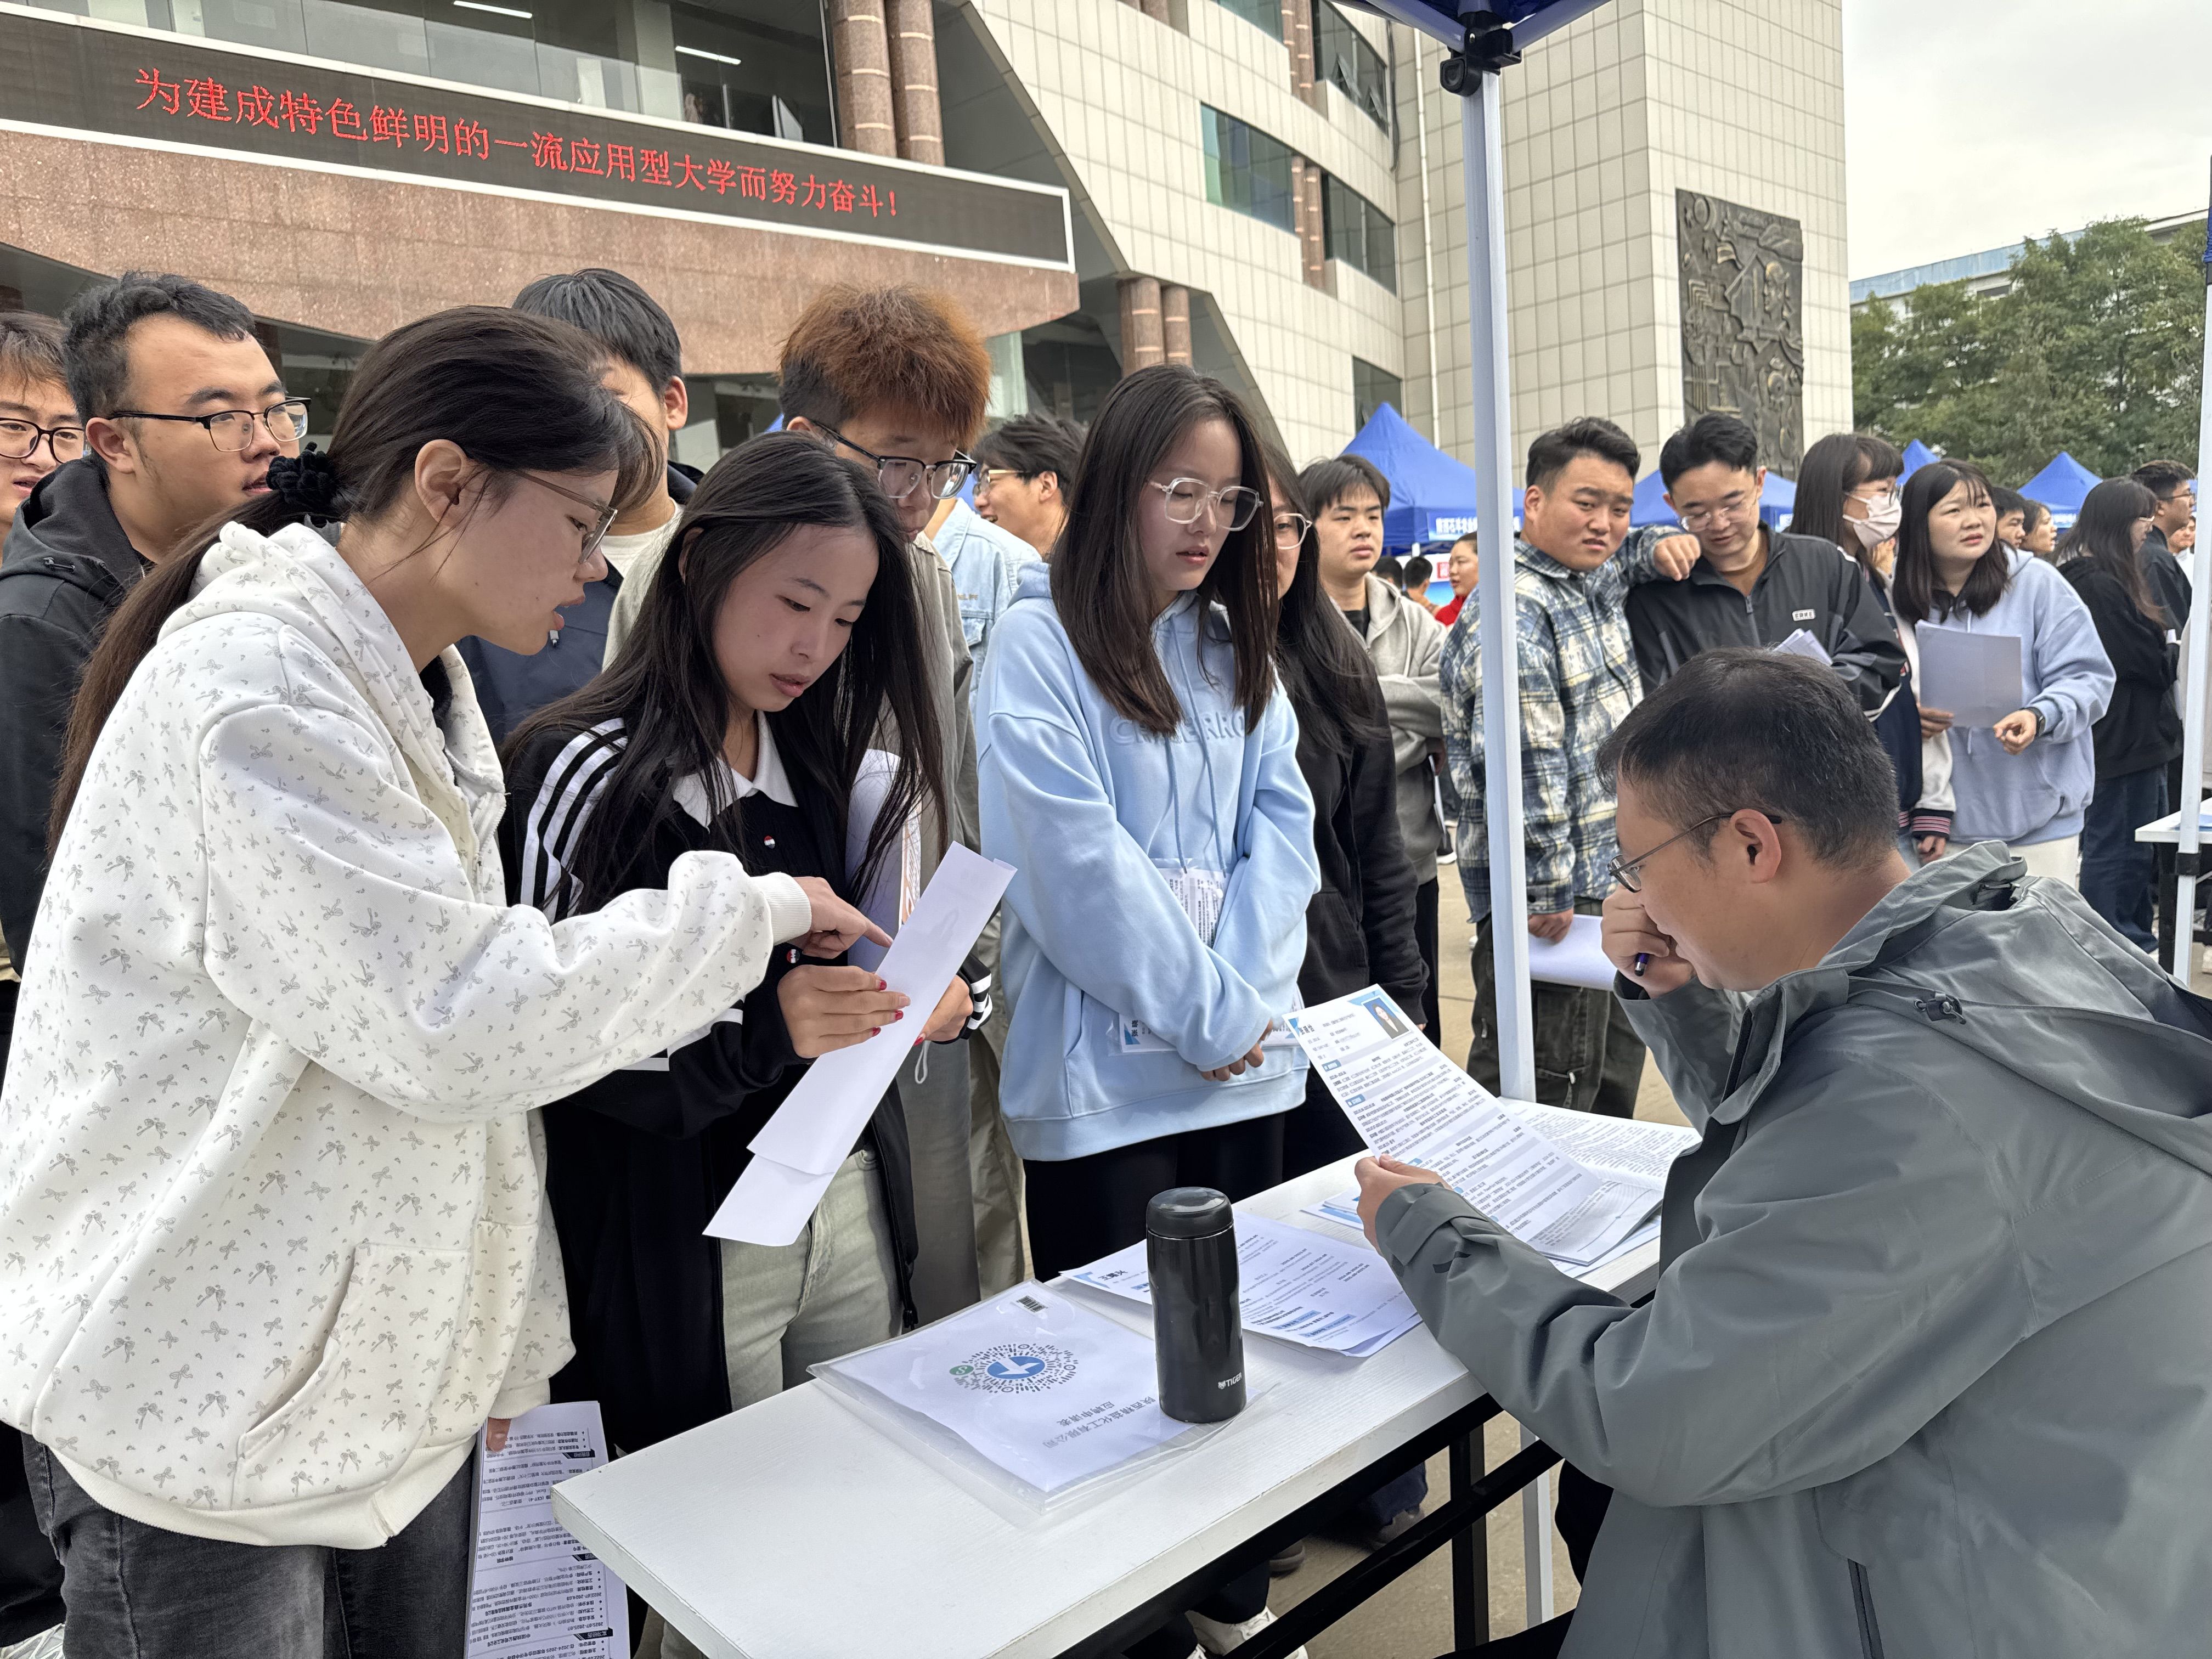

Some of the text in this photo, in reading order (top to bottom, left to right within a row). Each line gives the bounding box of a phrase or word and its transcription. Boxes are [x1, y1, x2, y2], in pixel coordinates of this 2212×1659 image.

[1226, 1372, 1242, 1387] TIGER
[1042, 1396, 1155, 1449] 陕西精益化工有限公司
[1056, 1401, 1115, 1427] 应聘申请表
